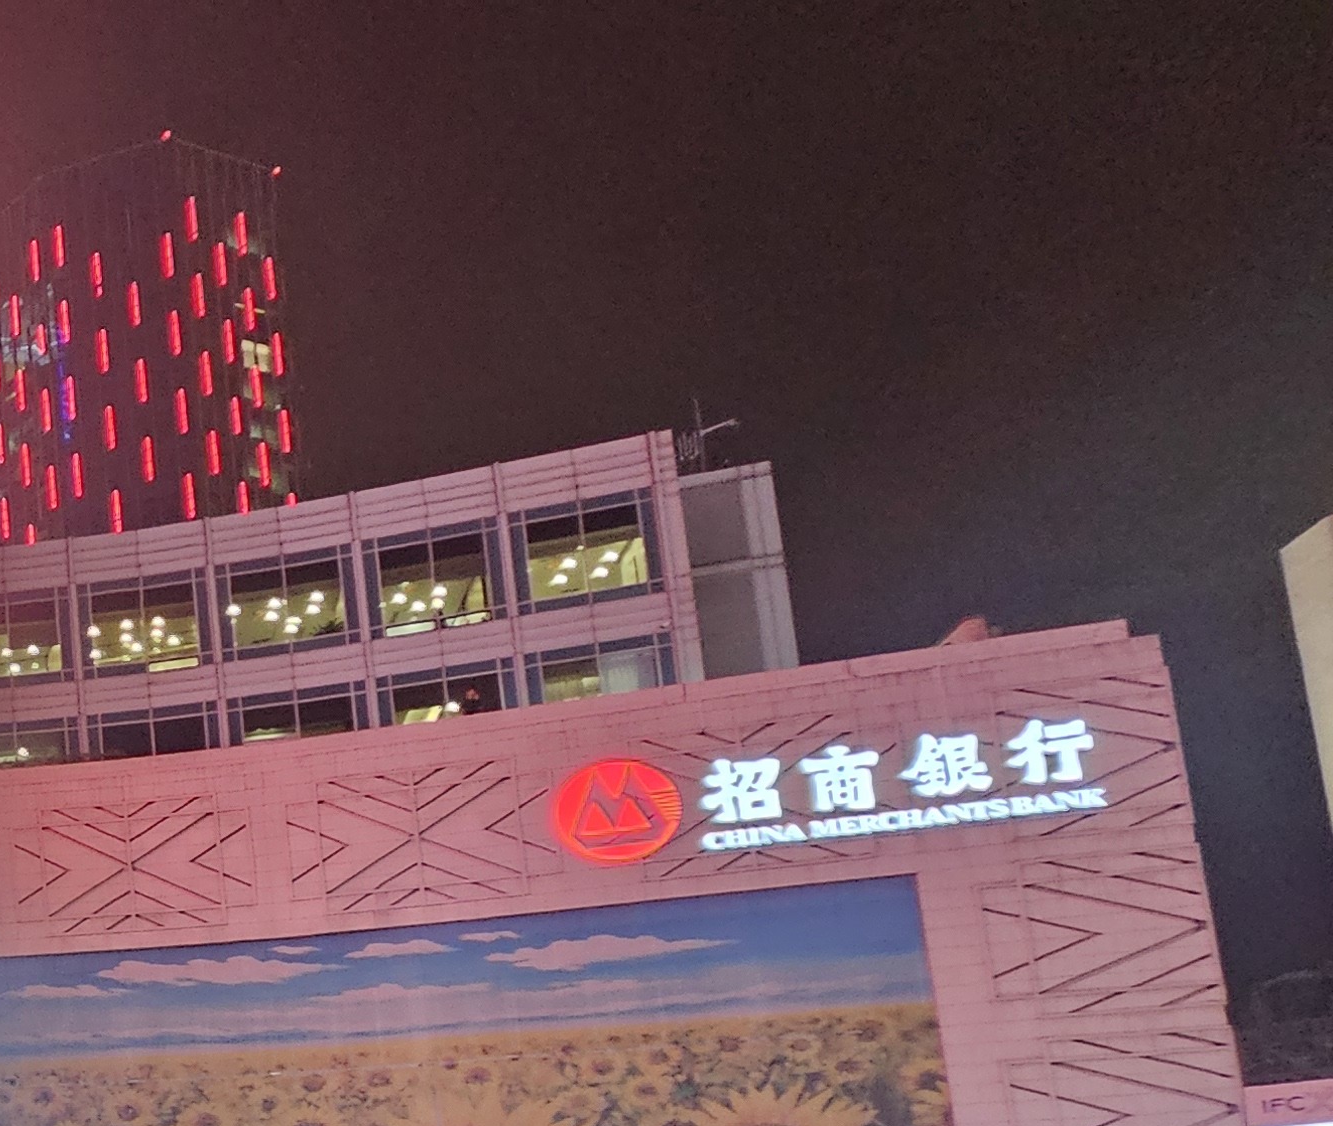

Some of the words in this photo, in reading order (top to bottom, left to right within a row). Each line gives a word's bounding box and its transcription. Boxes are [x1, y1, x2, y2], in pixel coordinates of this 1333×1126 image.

[701, 718, 1096, 824] 招商銀行
[701, 824, 808, 850] CHINA
[808, 798, 1011, 840] MERCHANTS
[1010, 787, 1109, 820] BANK
